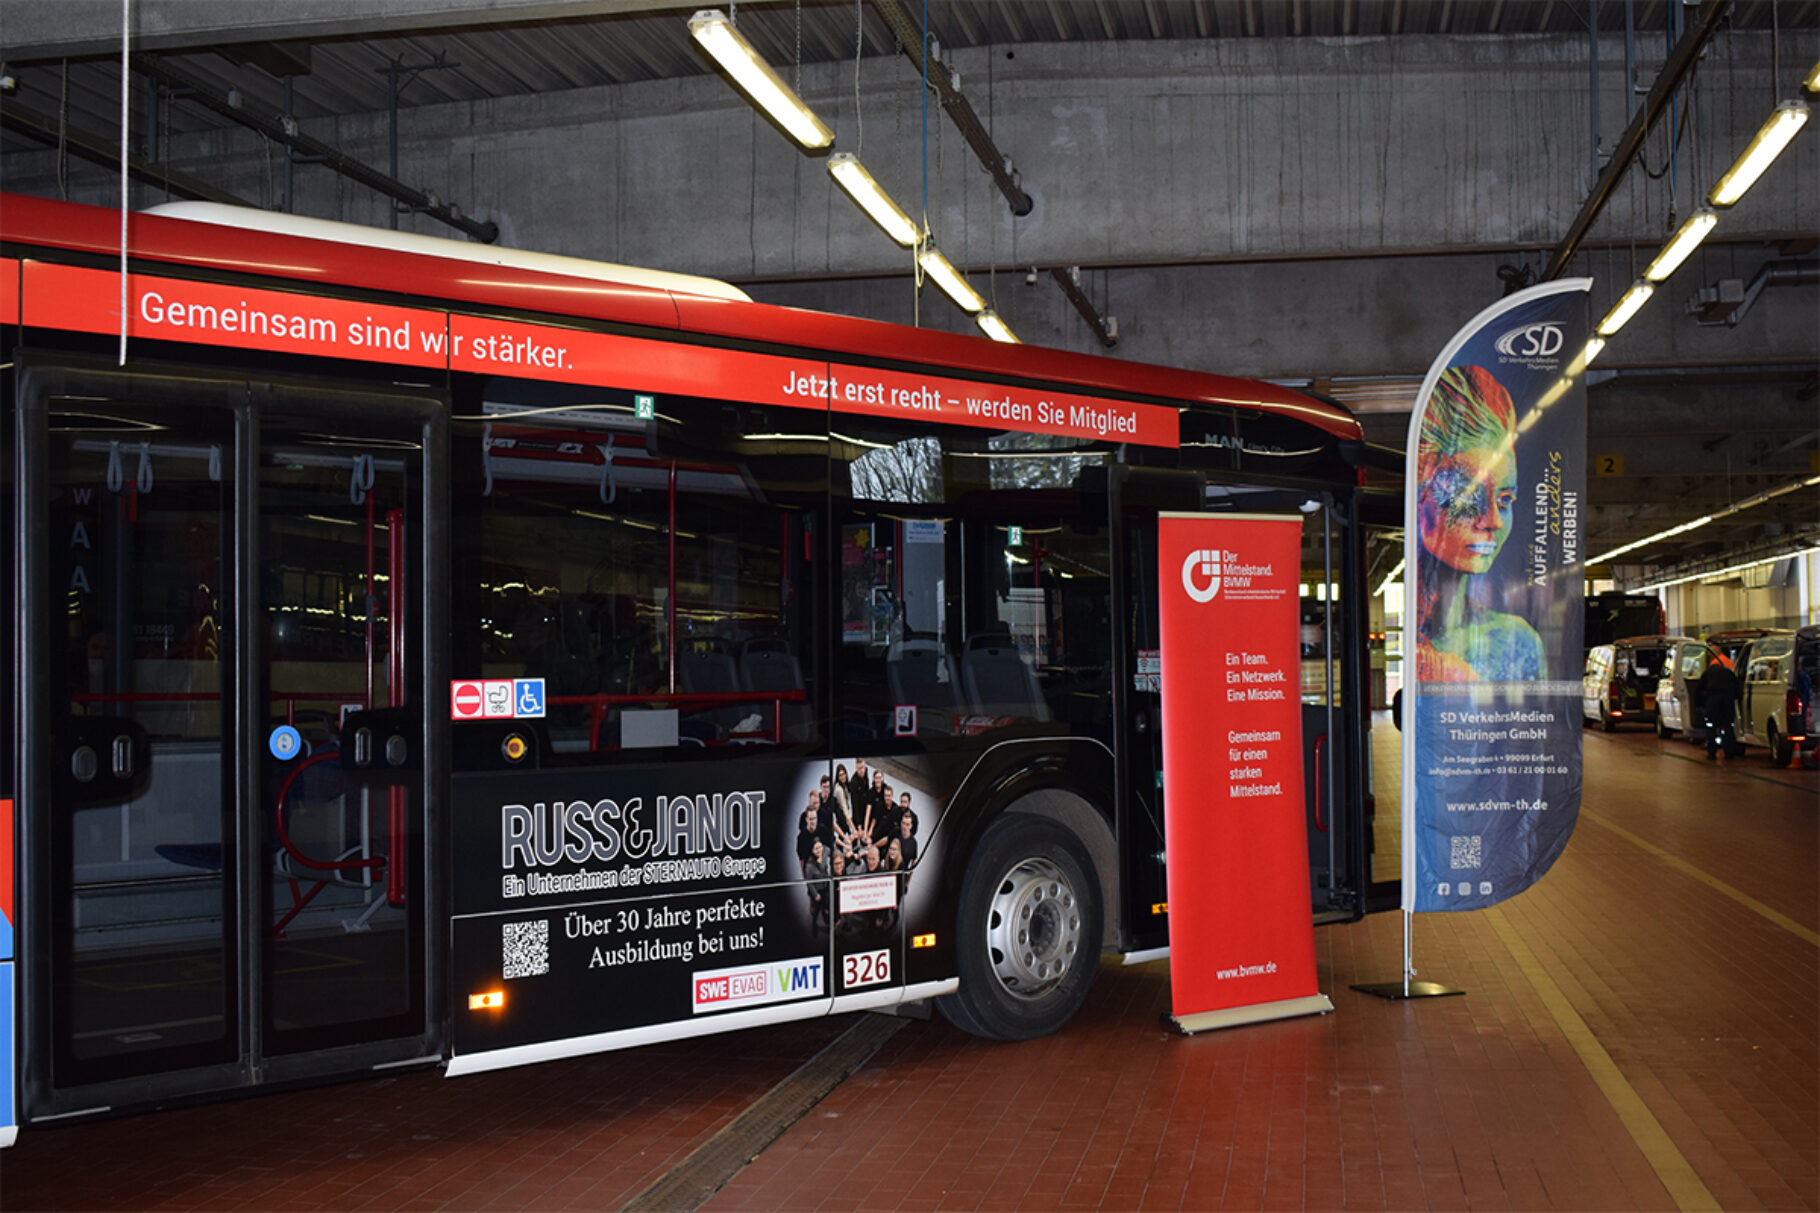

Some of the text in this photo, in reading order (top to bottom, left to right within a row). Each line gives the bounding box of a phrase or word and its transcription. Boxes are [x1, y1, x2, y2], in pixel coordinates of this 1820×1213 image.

[139, 292, 574, 370] Gemeinsam sind wir stärker.
[1521, 325, 1563, 356] SD
[783, 370, 839, 399] Jetzt
[845, 380, 885, 405] erst
[891, 384, 942, 411] recht
[966, 396, 1032, 422] werden
[1037, 402, 1065, 426] Sie
[1070, 407, 1137, 436] Mitglied
[1205, 433, 1244, 449] MAN
[1604, 458, 1616, 473] 2
[1546, 451, 1561, 535] anders
[1534, 468, 1549, 586] AUFFALLEND...
[1563, 492, 1577, 565] WERBEN!
[1223, 550, 1238, 562] Der
[1223, 564, 1274, 576] Mittelstand.
[1223, 577, 1252, 588] BVMW
[1226, 652, 1268, 666] Ein Team.
[1226, 669, 1287, 684] Ein Netzwerk.
[1226, 688, 1285, 702] Eine Mission.
[1440, 710, 1555, 723] SD VerkehrsMedien
[1228, 729, 1281, 744] Gemeinsam
[1449, 728, 1548, 743] Thüringen GmbH
[1229, 748, 1267, 761] für einen
[1505, 754, 1530, 762] 99099
[1531, 753, 1555, 762] Erfurt
[1229, 766, 1263, 780] starken
[1229, 782, 1284, 798] Mittelstand.
[1446, 798, 1548, 811] www.sdvm-th.de
[503, 855, 767, 898] Ein Unternehmen der STERNAUTO Gruppe
[564, 898, 765, 939] Über 30 Jahre perfekte
[588, 927, 765, 968] Ausbildung bei uns!
[846, 952, 888, 985] 326
[1216, 960, 1277, 980] www.bvmw.de
[777, 963, 821, 993] VMT
[699, 973, 765, 1000] SWE EVAG
